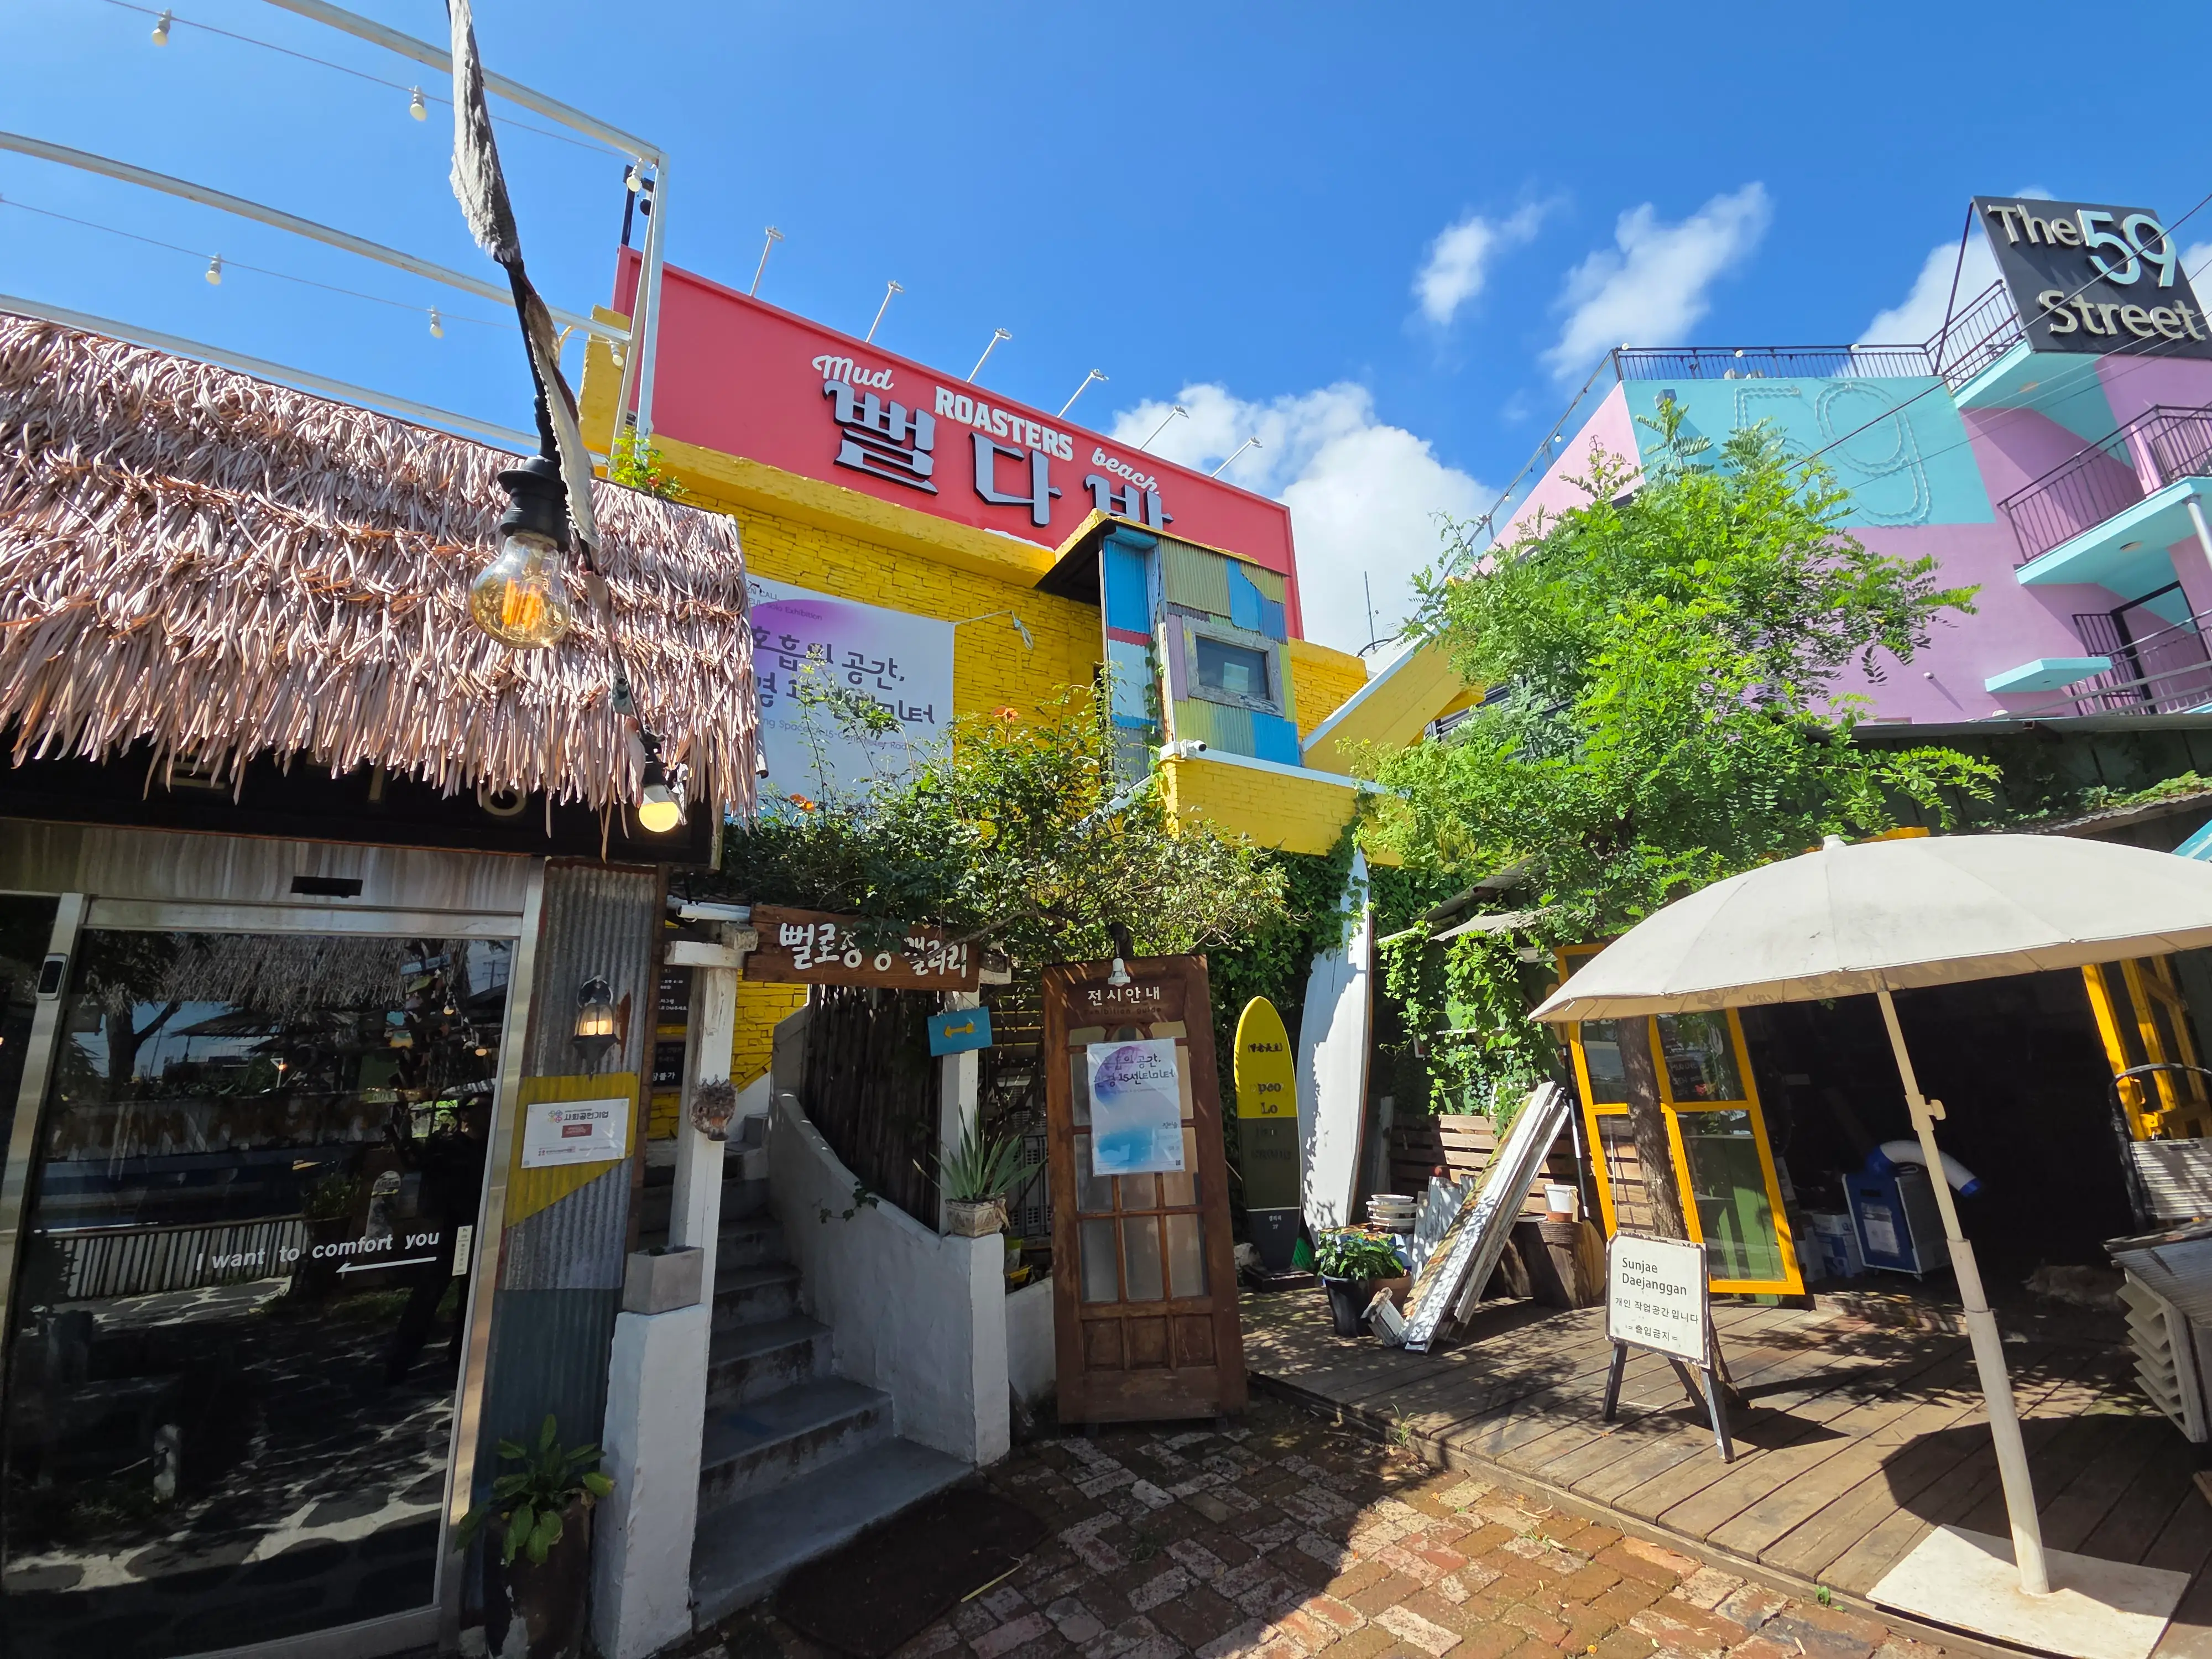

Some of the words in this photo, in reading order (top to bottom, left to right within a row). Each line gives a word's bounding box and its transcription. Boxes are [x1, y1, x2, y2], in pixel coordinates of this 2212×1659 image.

[1987, 204, 2082, 246] The
[2075, 208, 2177, 288] 59
[2036, 289, 2206, 341] Street
[812, 354, 894, 390] Mud
[935, 386, 1073, 461] ROASTERS
[1092, 447, 1160, 494] beach
[785, 606, 823, 620] Exhibition
[1087, 986, 1160, 1006] 전시안내
[196, 1253, 204, 1271] I
[212, 1247, 265, 1270] want
[279, 1244, 300, 1263] to
[312, 1234, 394, 1259] comfort
[405, 1232, 440, 1250] you
[1622, 1257, 1658, 1274] Sunjae
[1622, 1273, 1687, 1296] Daejanggan
[1615, 1297, 1631, 1308] 개인
